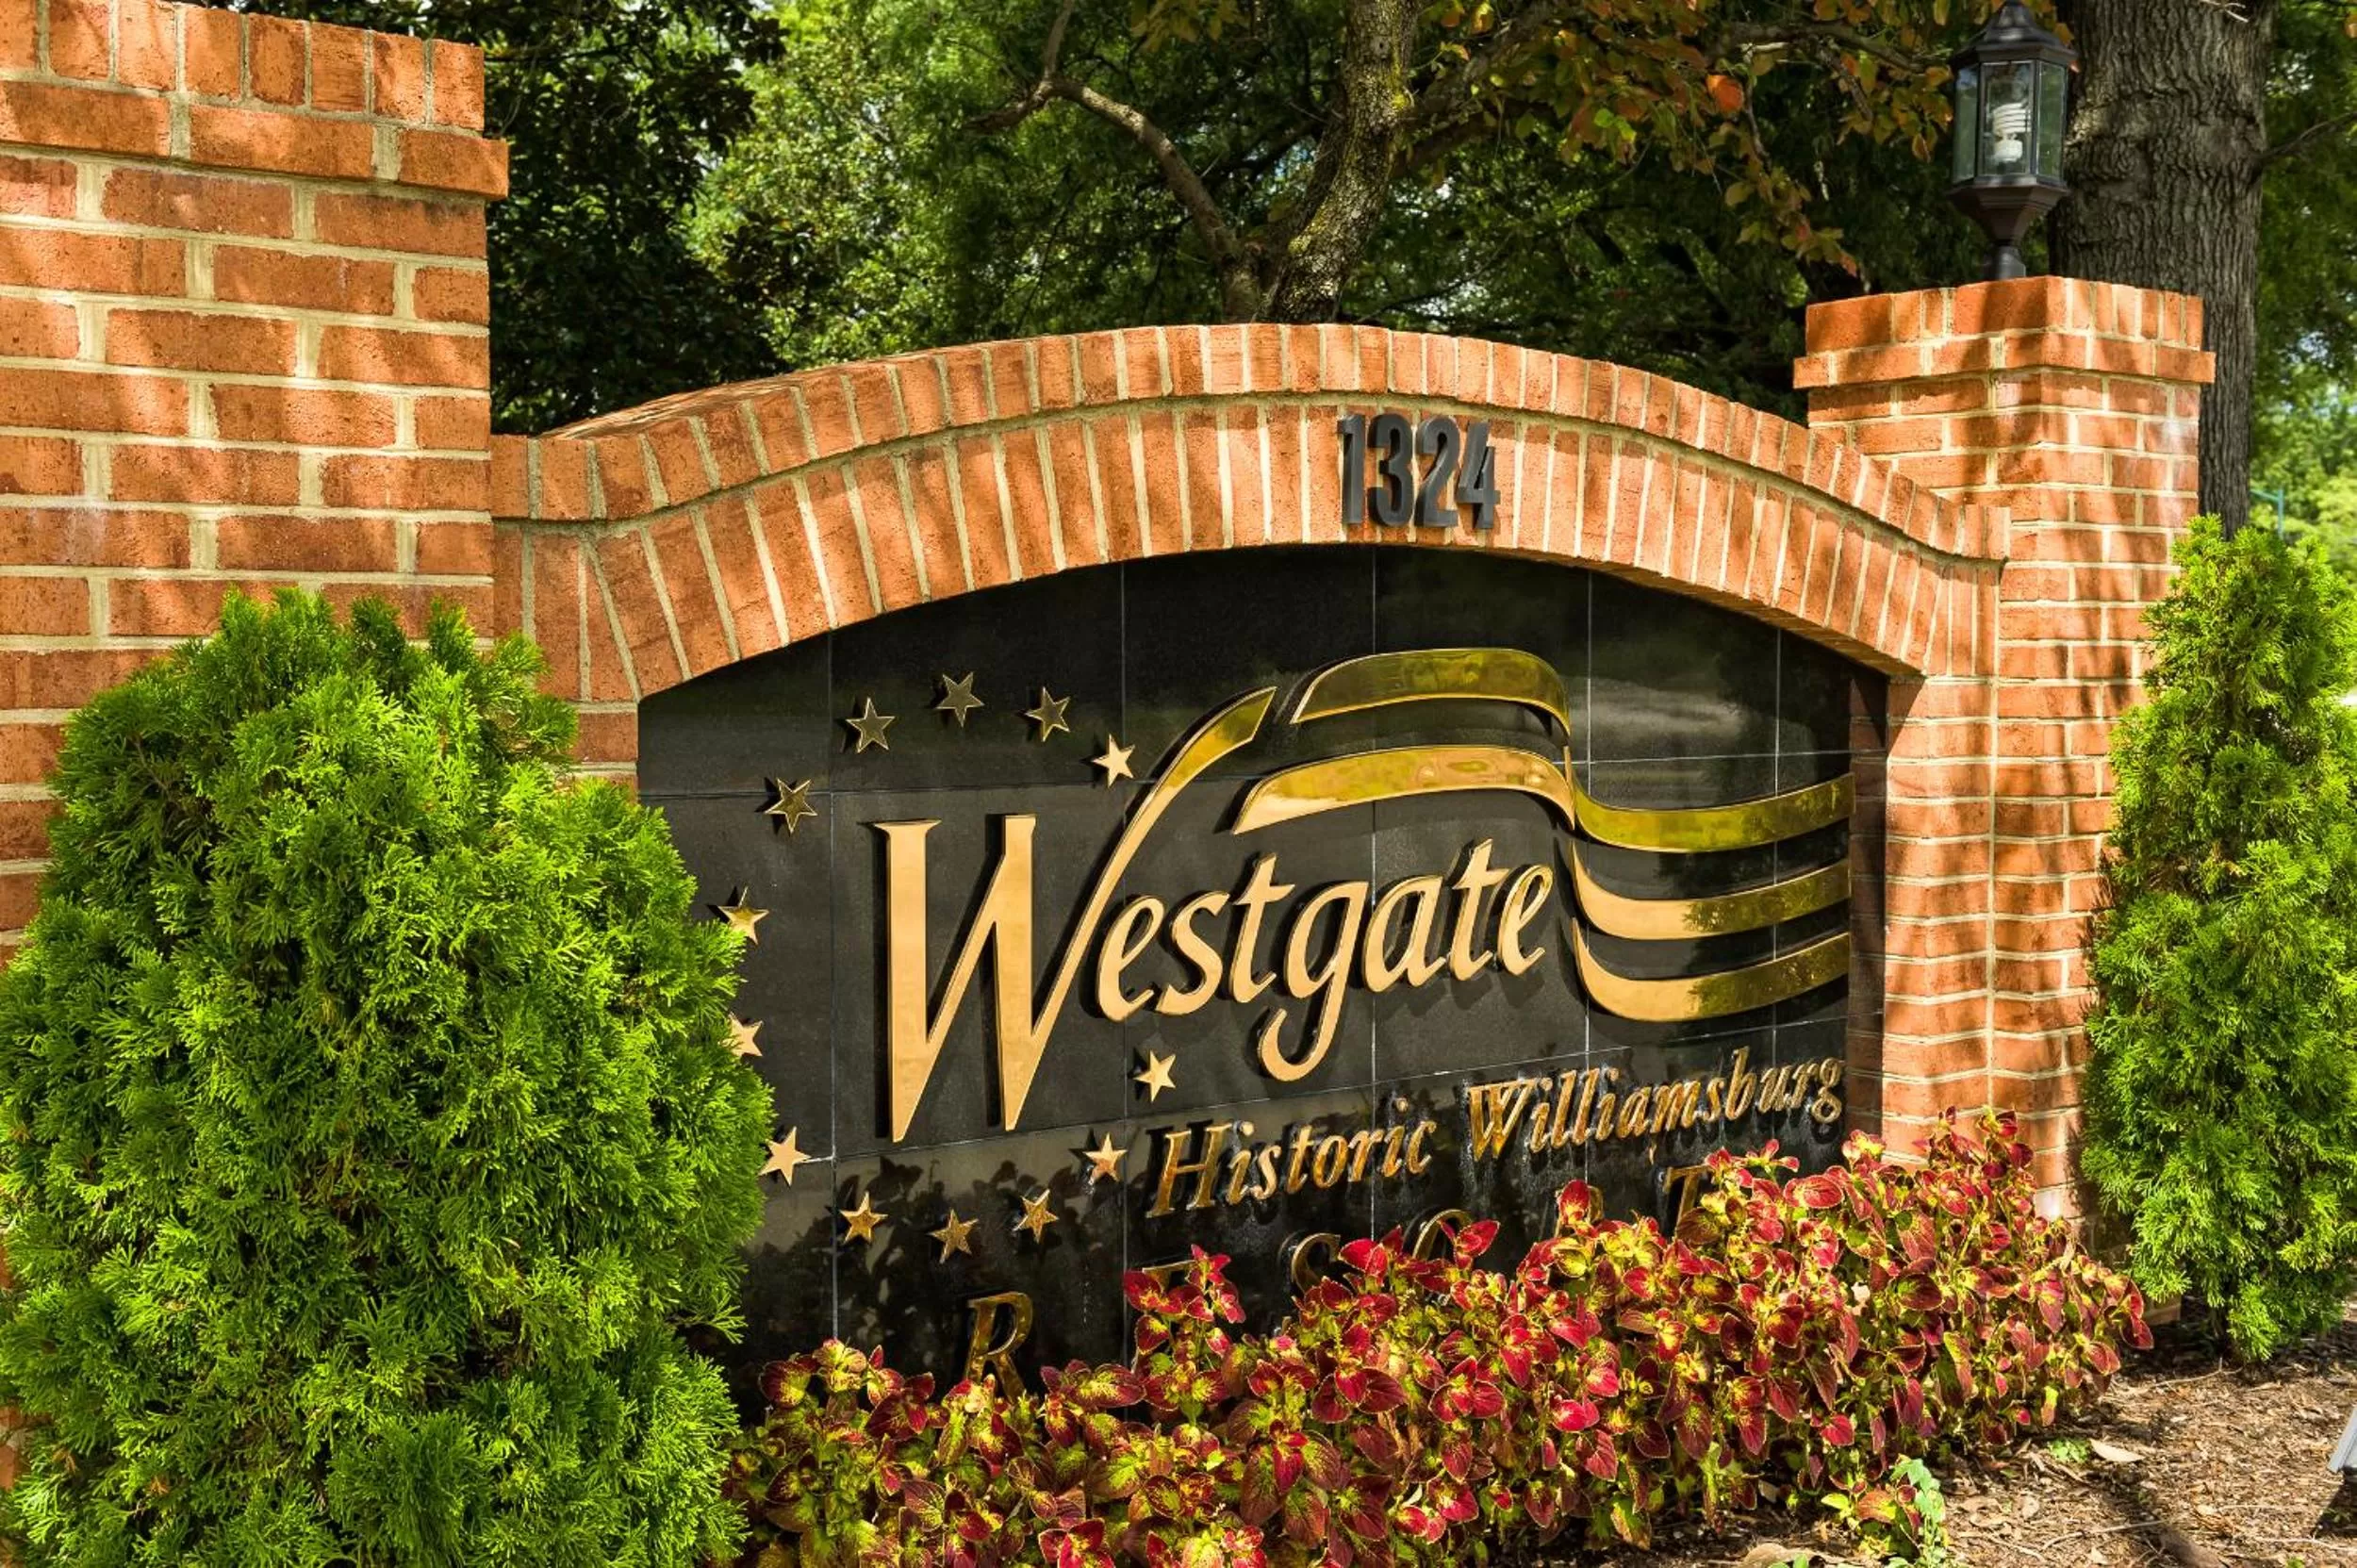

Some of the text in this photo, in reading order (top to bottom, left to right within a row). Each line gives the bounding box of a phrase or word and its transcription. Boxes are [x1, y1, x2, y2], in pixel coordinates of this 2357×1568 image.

[1337, 413, 1501, 529] 1324
[868, 685, 1554, 1143] Westgate
[1146, 1047, 1843, 1218] Historic Williamsburg
